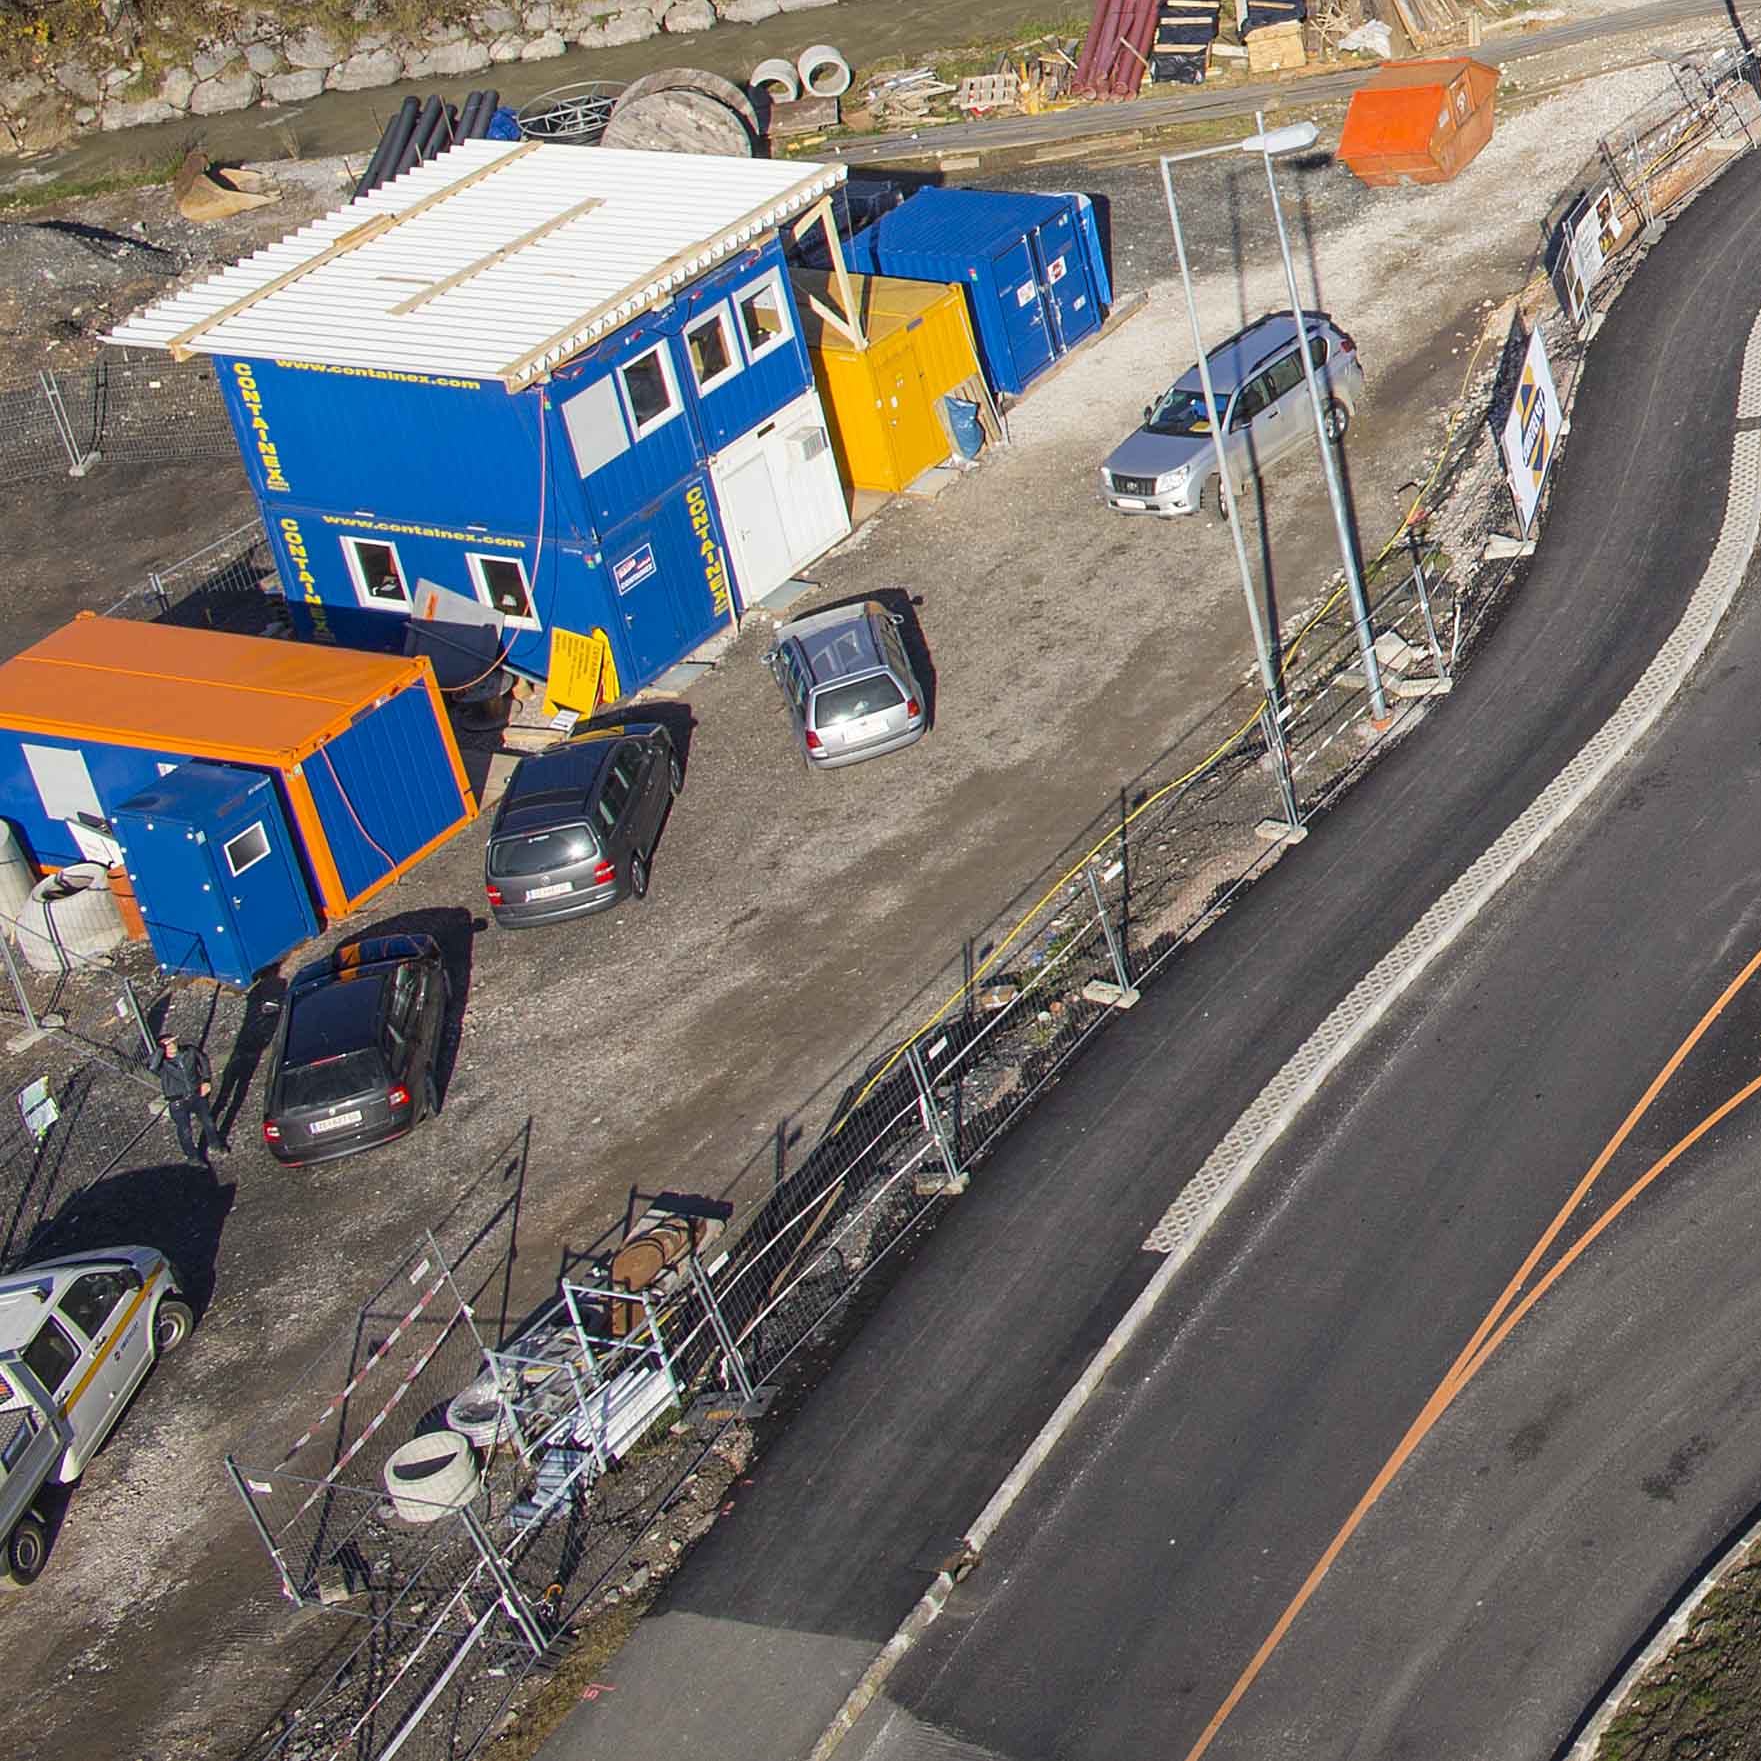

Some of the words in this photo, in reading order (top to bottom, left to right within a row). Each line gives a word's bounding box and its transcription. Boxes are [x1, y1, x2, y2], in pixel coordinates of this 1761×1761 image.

[233, 362, 285, 482] CONTAINEX
[273, 358, 481, 391] www.containex.com
[279, 518, 330, 633] CONTAINEX
[321, 513, 526, 549] www.containex.com
[684, 485, 729, 609] CONTAINEX
